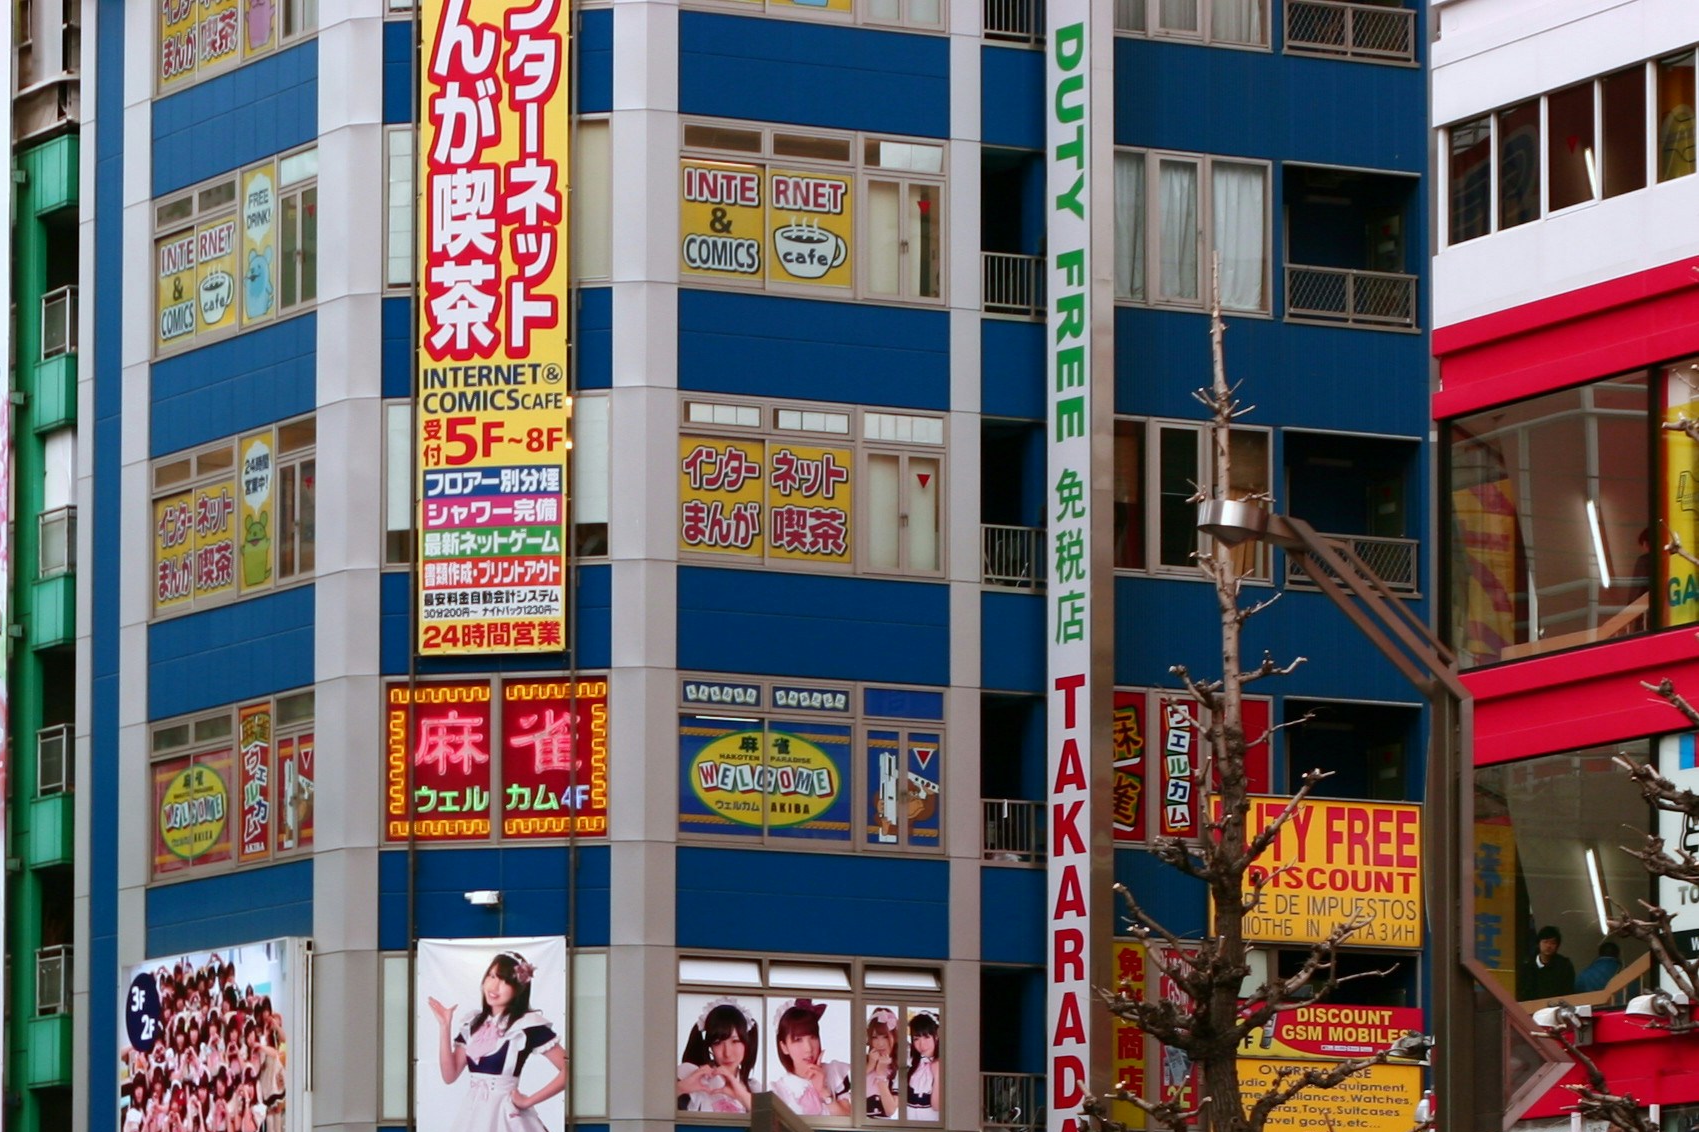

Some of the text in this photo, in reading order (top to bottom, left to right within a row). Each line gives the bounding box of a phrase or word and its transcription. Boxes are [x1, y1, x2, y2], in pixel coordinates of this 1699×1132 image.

[248, 188, 269, 209] FREE
[709, 207, 733, 233] &
[1055, 23, 1084, 443] DUTY FREE
[683, 236, 758, 272] COMICS
[782, 246, 829, 268] cafe
[172, 276, 184, 300] &
[160, 299, 195, 340] COMICS
[203, 297, 226, 315] cafe
[423, 364, 541, 389] INTERNET
[423, 389, 562, 414] COMICS CAFE
[423, 419, 442, 467] 受付
[245, 452, 270, 477] 24時間
[425, 468, 560, 496] フロアー別分煙
[428, 497, 558, 527] シャワー完備
[424, 528, 560, 557] 最新ネットゲーム
[1055, 468, 1085, 645] 免税店
[424, 560, 560, 588] 書類作成・プリントアウト
[424, 589, 559, 607] 最安料金自動会計システム
[422, 621, 561, 649] 24時間営業
[1166, 704, 1190, 826] ウェルカム
[699, 761, 832, 797] WELCOME
[770, 802, 810, 815] AKIBA
[1326, 806, 1417, 869] FREE
[1249, 865, 1416, 894] DISCOUNT
[1307, 896, 1417, 921] IMPUESTOS
[131, 985, 146, 1012] 3F
[141, 1014, 155, 1040] 2F
[1296, 1007, 1393, 1026] DISCOUNT
[1281, 1025, 1322, 1041] GSM
